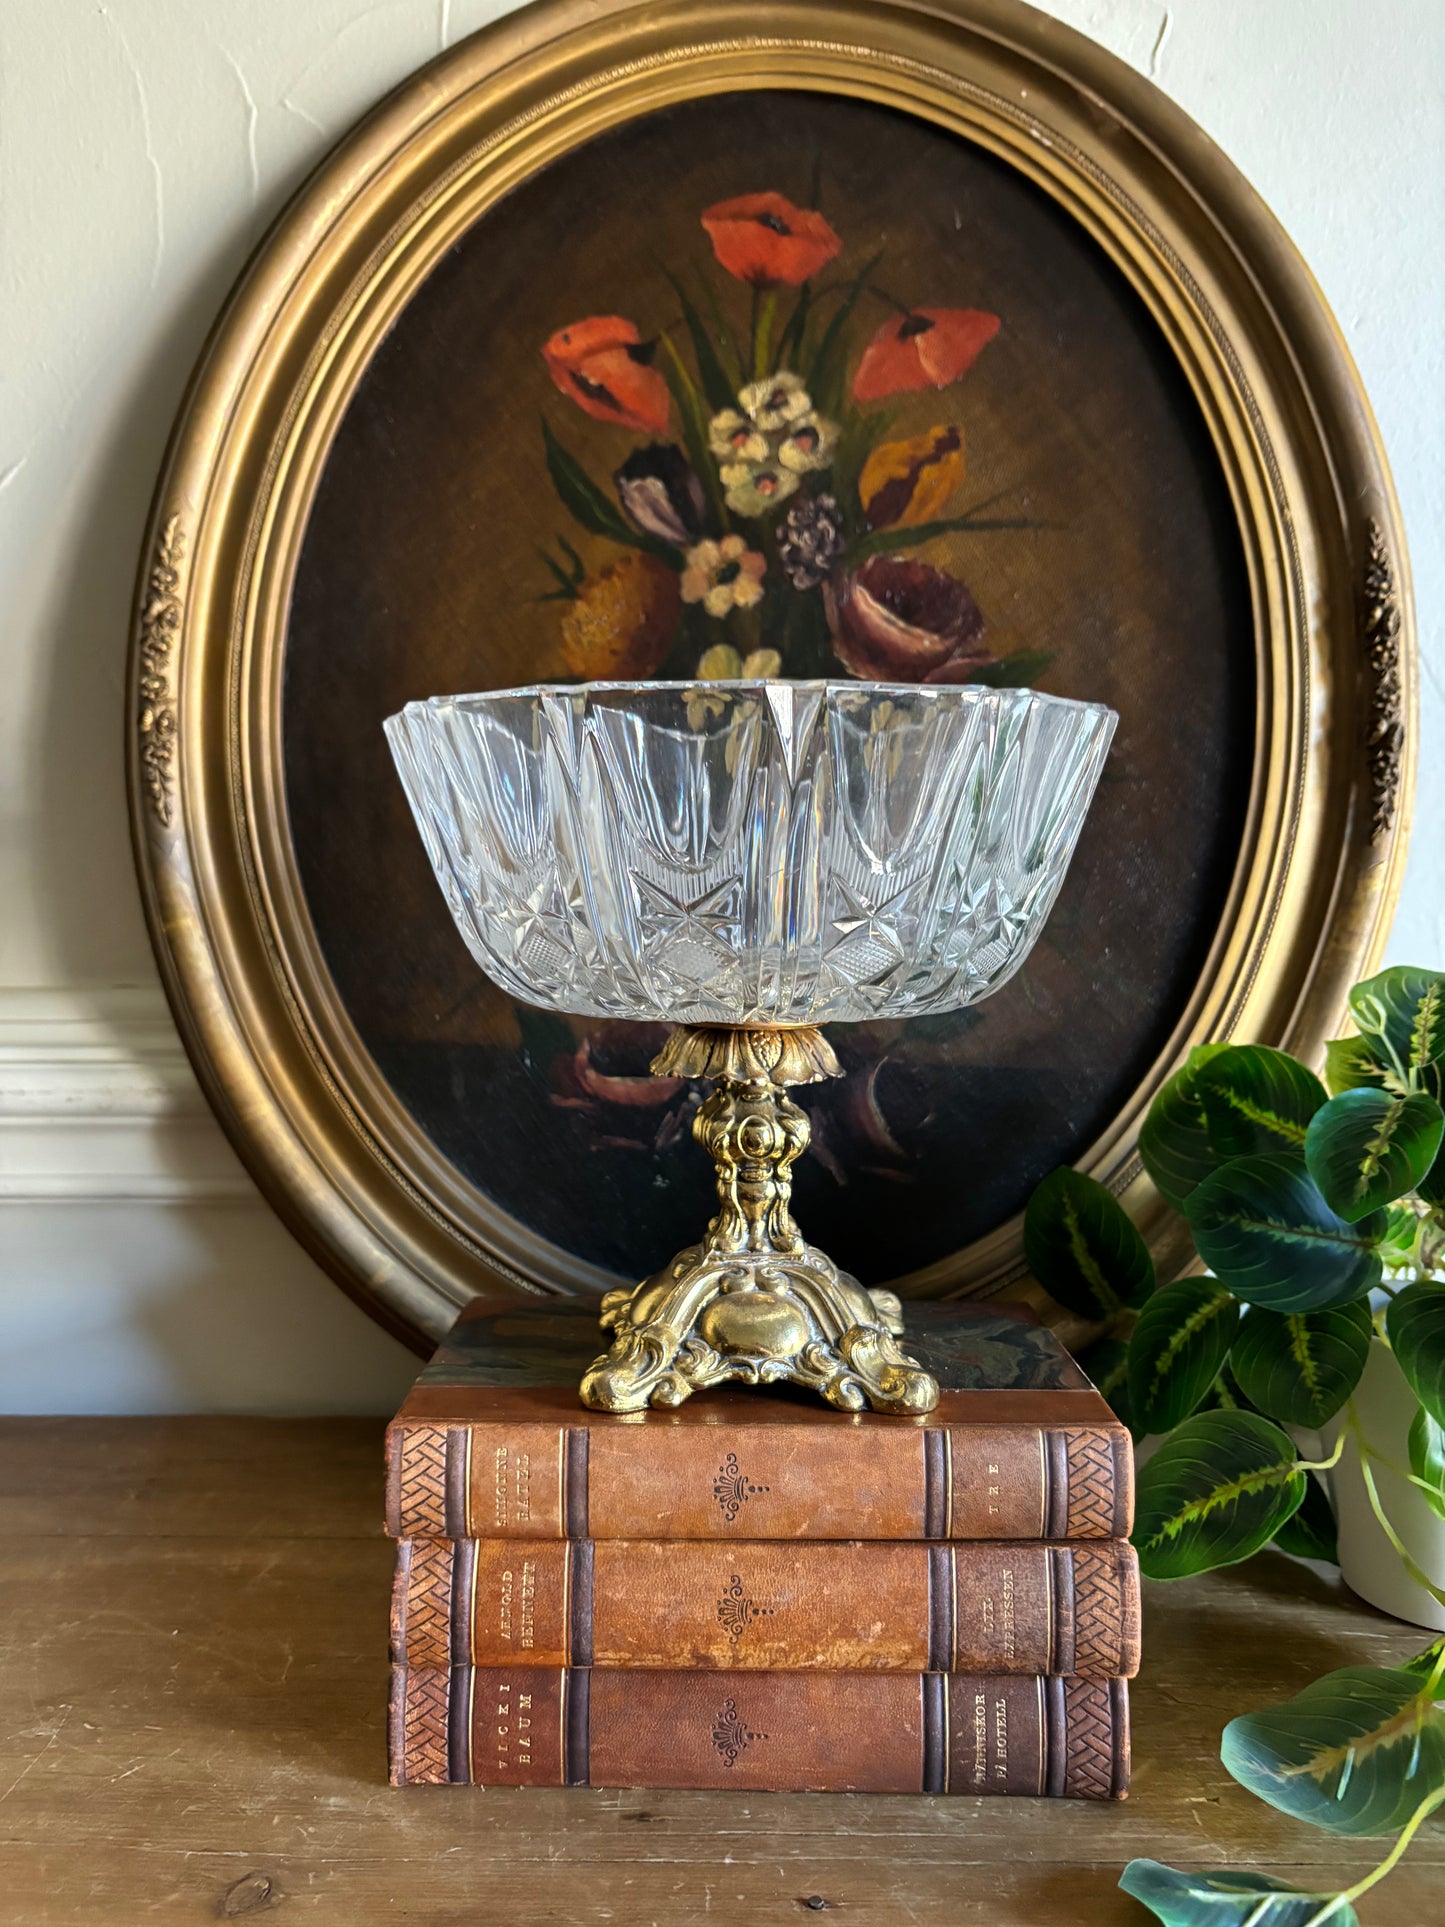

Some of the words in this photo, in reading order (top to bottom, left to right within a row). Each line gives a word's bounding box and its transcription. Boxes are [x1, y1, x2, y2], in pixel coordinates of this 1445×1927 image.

[988, 1464, 1000, 1515] TRE
[1002, 1568, 1015, 1659] EXPRESSEN
[498, 1684, 511, 1769] VICKI
[518, 1694, 532, 1764] BAUM
[995, 1698, 1008, 1759] HOTELL
